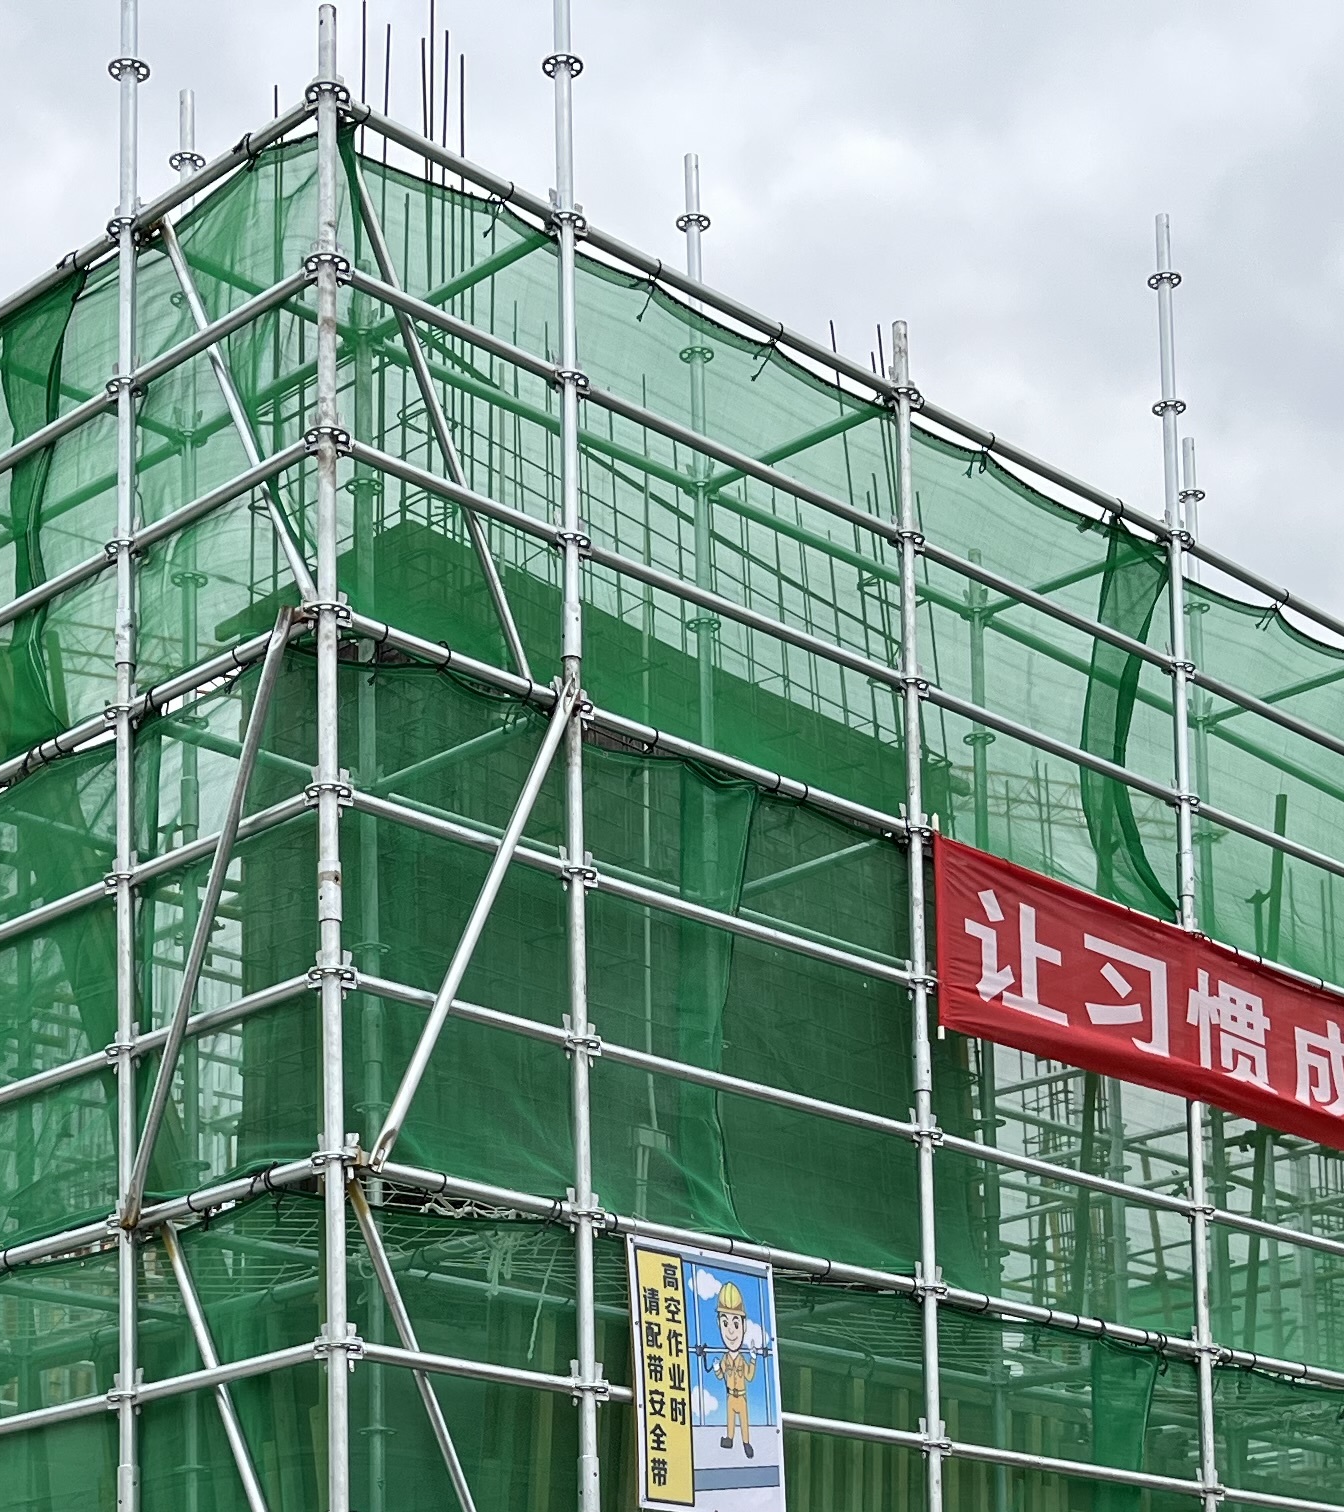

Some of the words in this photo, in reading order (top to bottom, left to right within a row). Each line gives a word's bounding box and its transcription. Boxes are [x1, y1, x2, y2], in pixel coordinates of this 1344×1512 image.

[642, 1286, 668, 1487] 请配带安全带
[661, 1263, 687, 1426] 高空作业时
